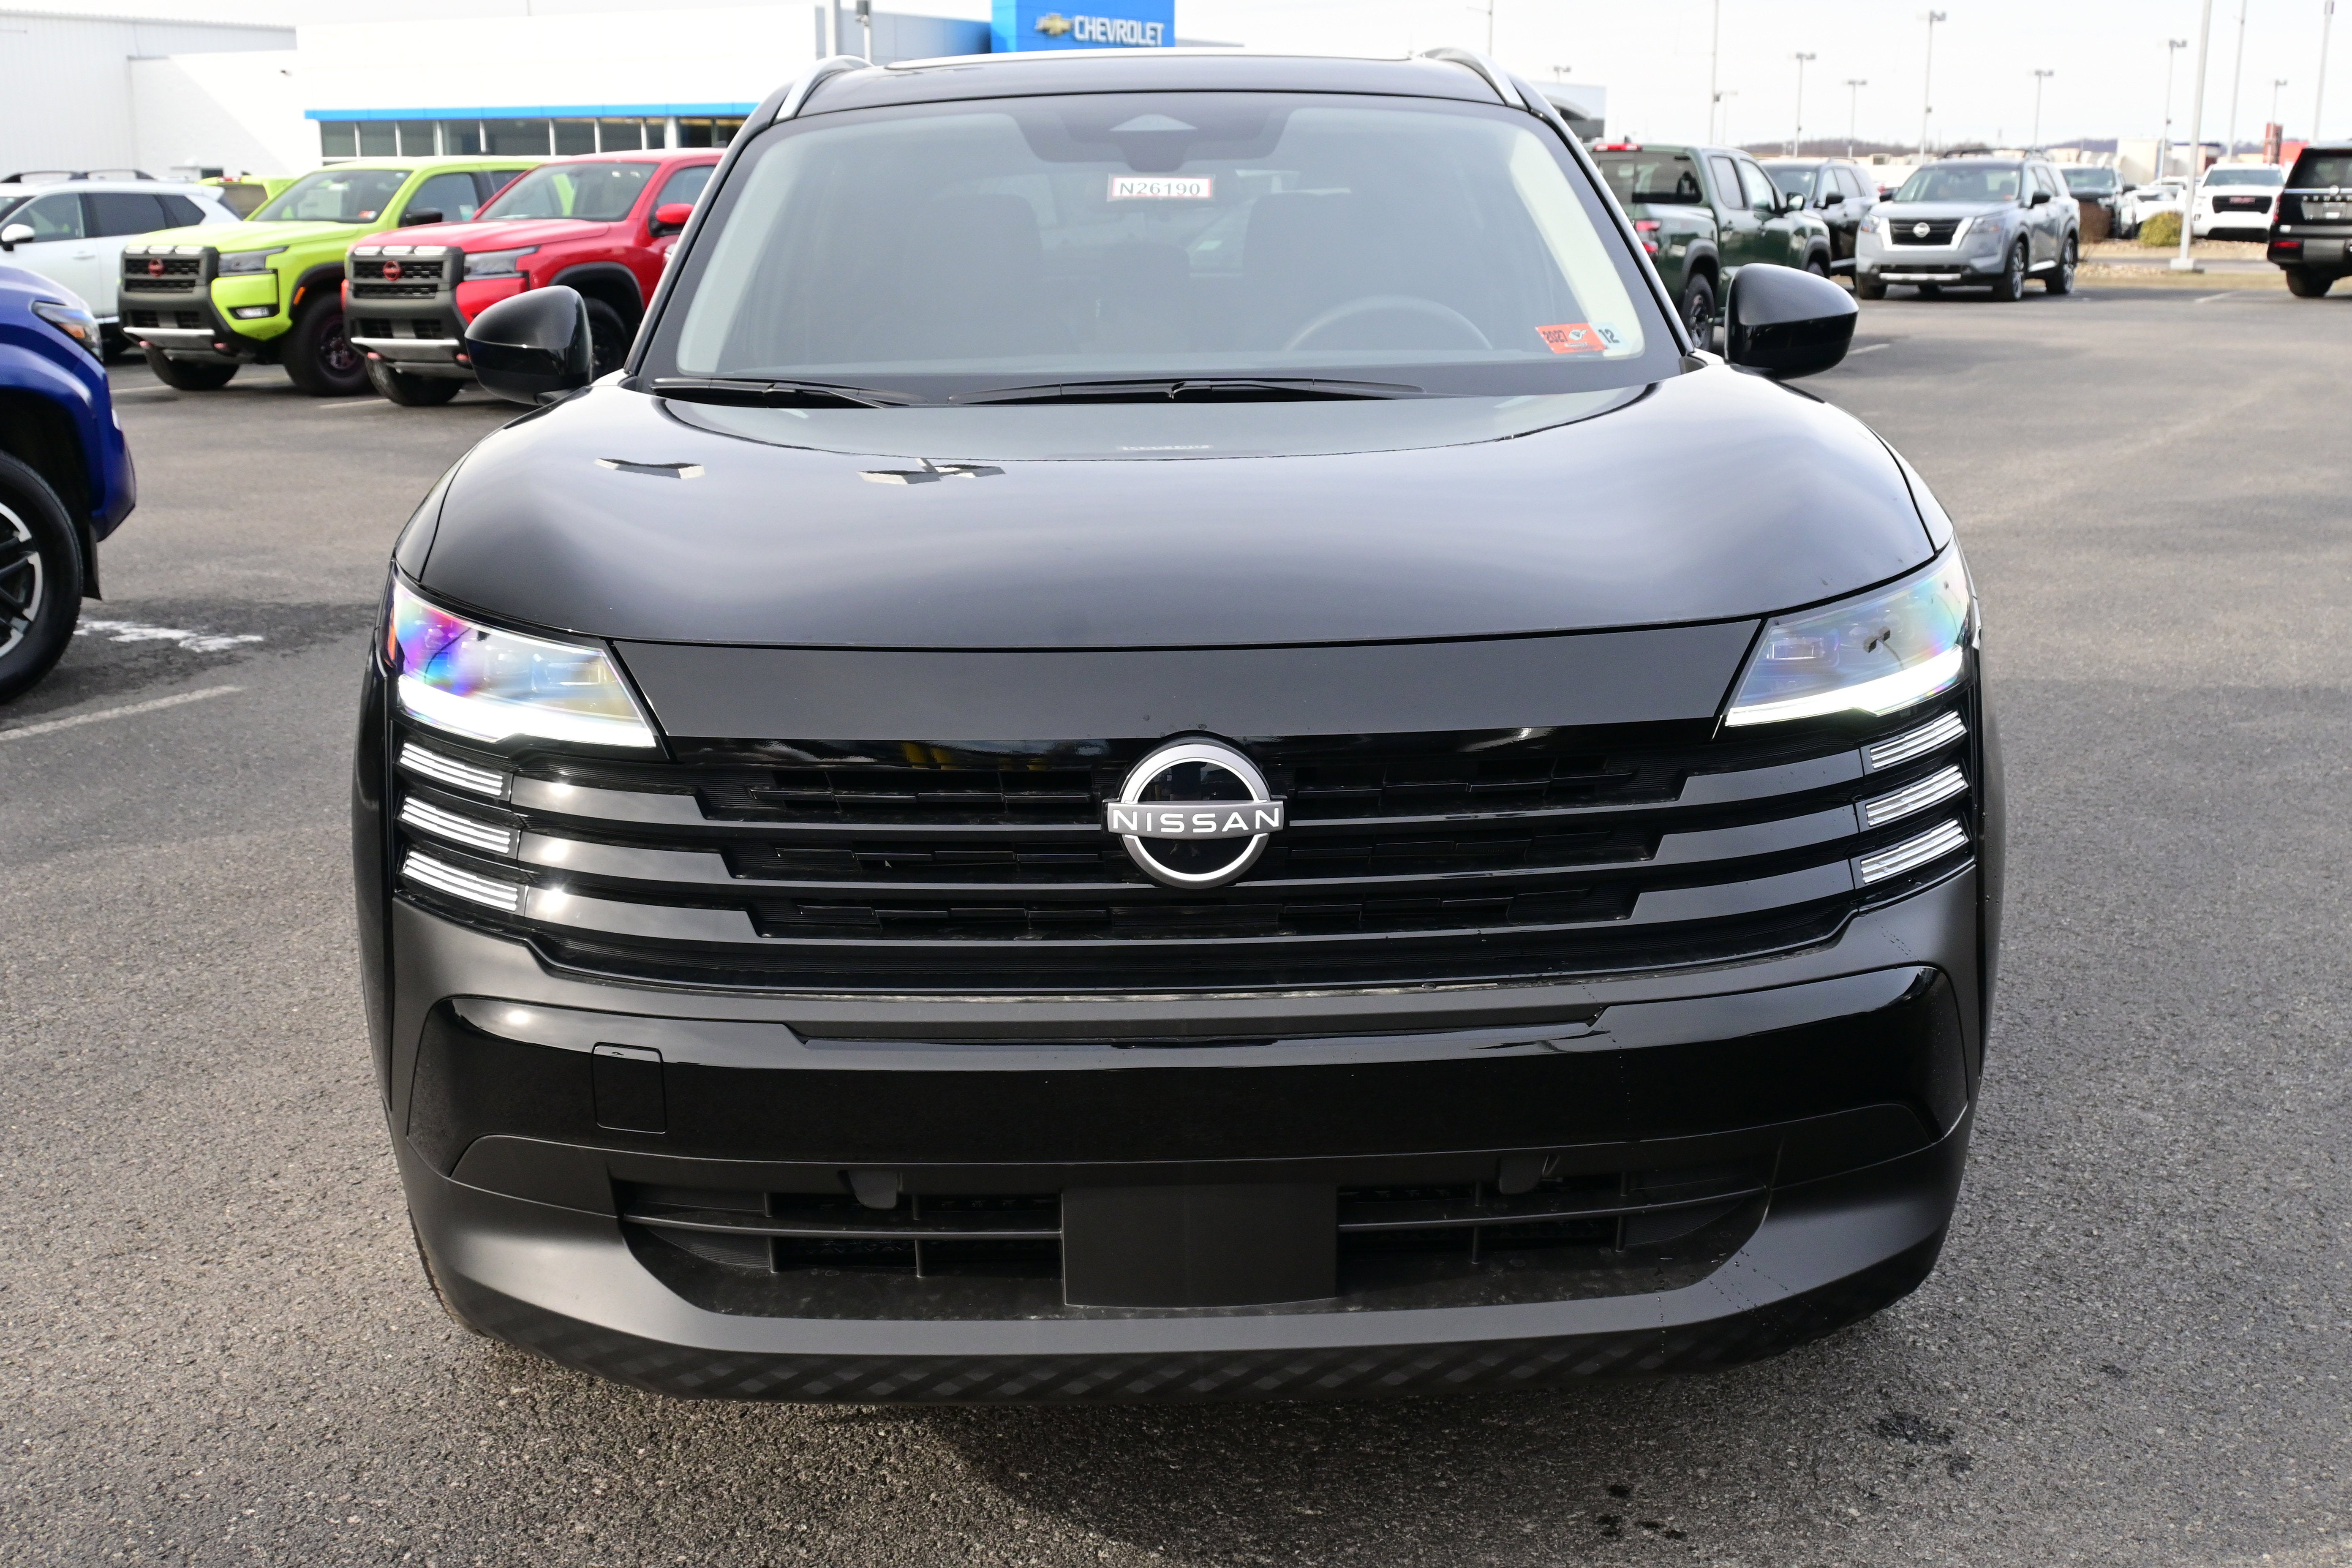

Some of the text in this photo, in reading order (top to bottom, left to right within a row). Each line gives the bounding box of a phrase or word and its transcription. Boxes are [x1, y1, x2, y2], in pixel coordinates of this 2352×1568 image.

[1074, 15, 1164, 47] CHEVROLET
[1120, 182, 1200, 196] N26190
[1542, 329, 1620, 343] 2027 12
[1112, 807, 1279, 833] NISSAN
